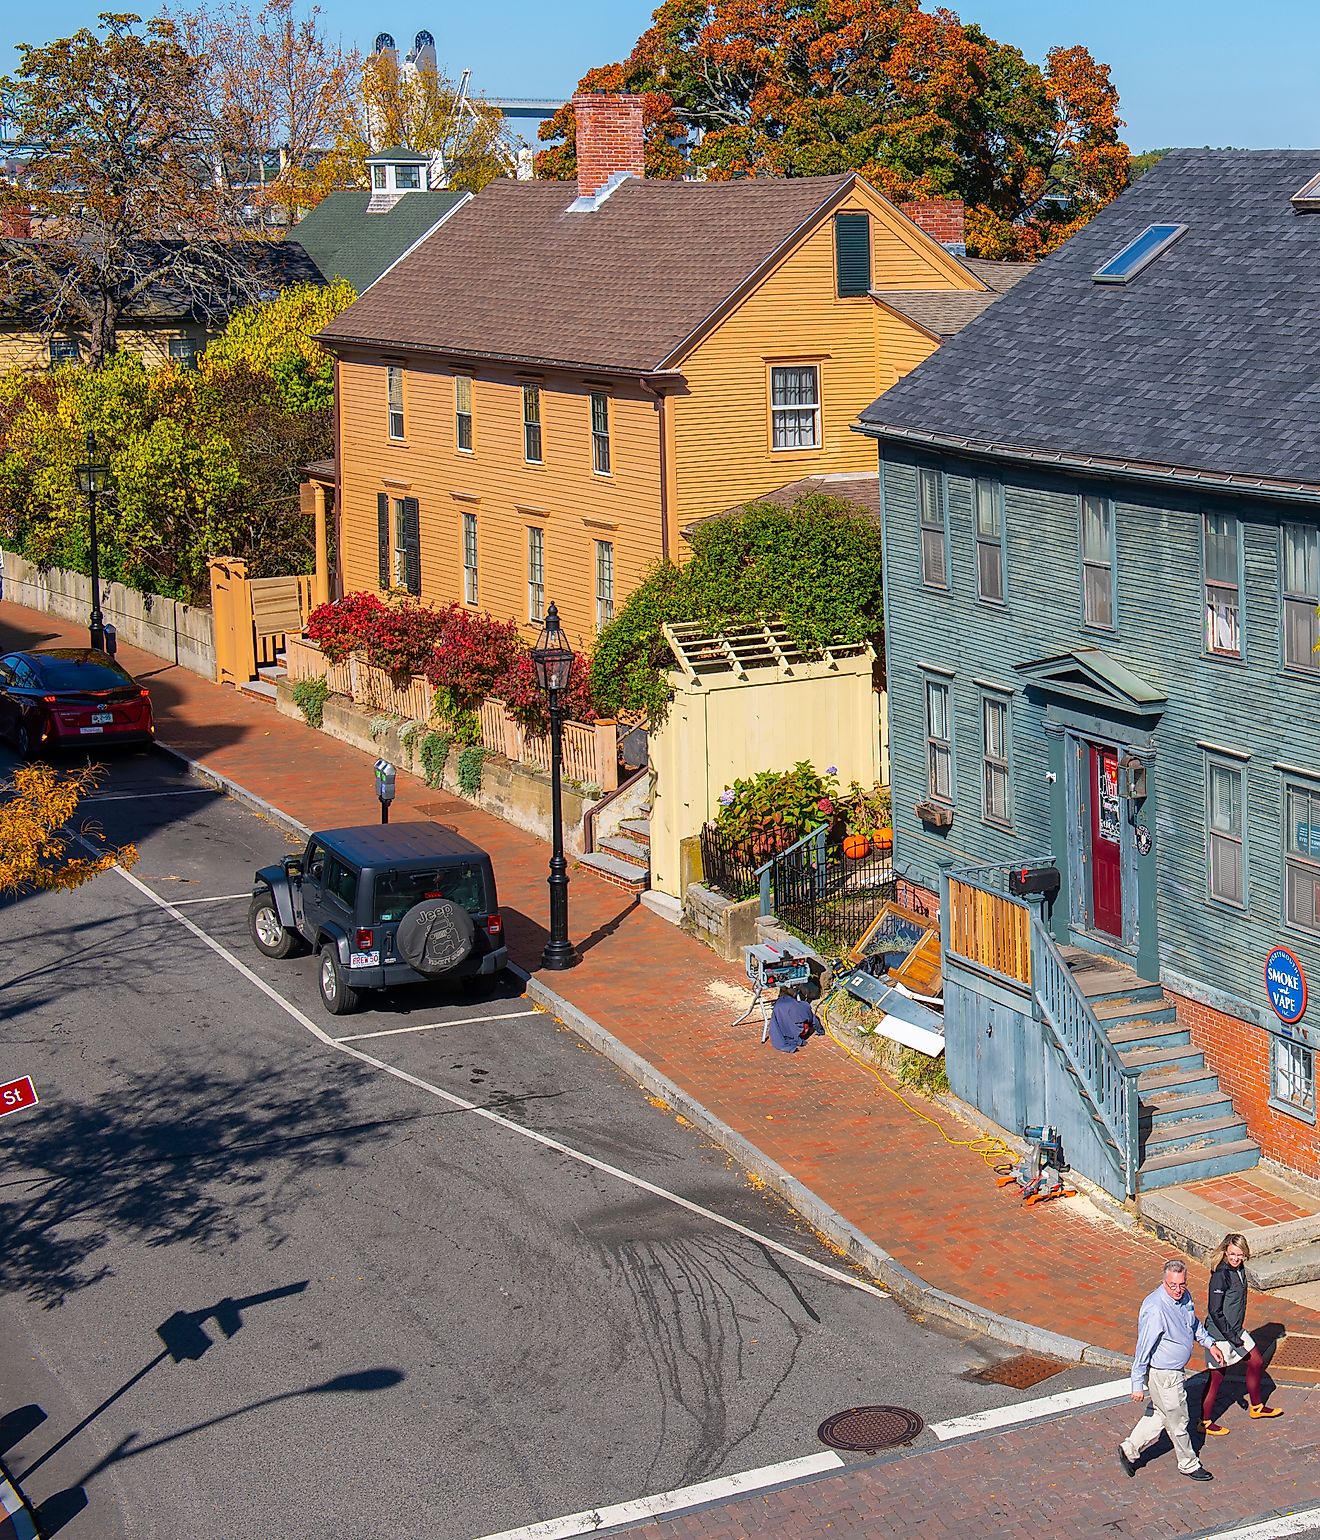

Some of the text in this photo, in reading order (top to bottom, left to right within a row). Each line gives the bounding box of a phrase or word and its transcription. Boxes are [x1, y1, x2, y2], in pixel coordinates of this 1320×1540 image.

[416, 904, 452, 925] Jeep
[1267, 967, 1299, 990] SMOKE
[1272, 991, 1295, 1012] VAPE
[3, 1088, 23, 1105] St
